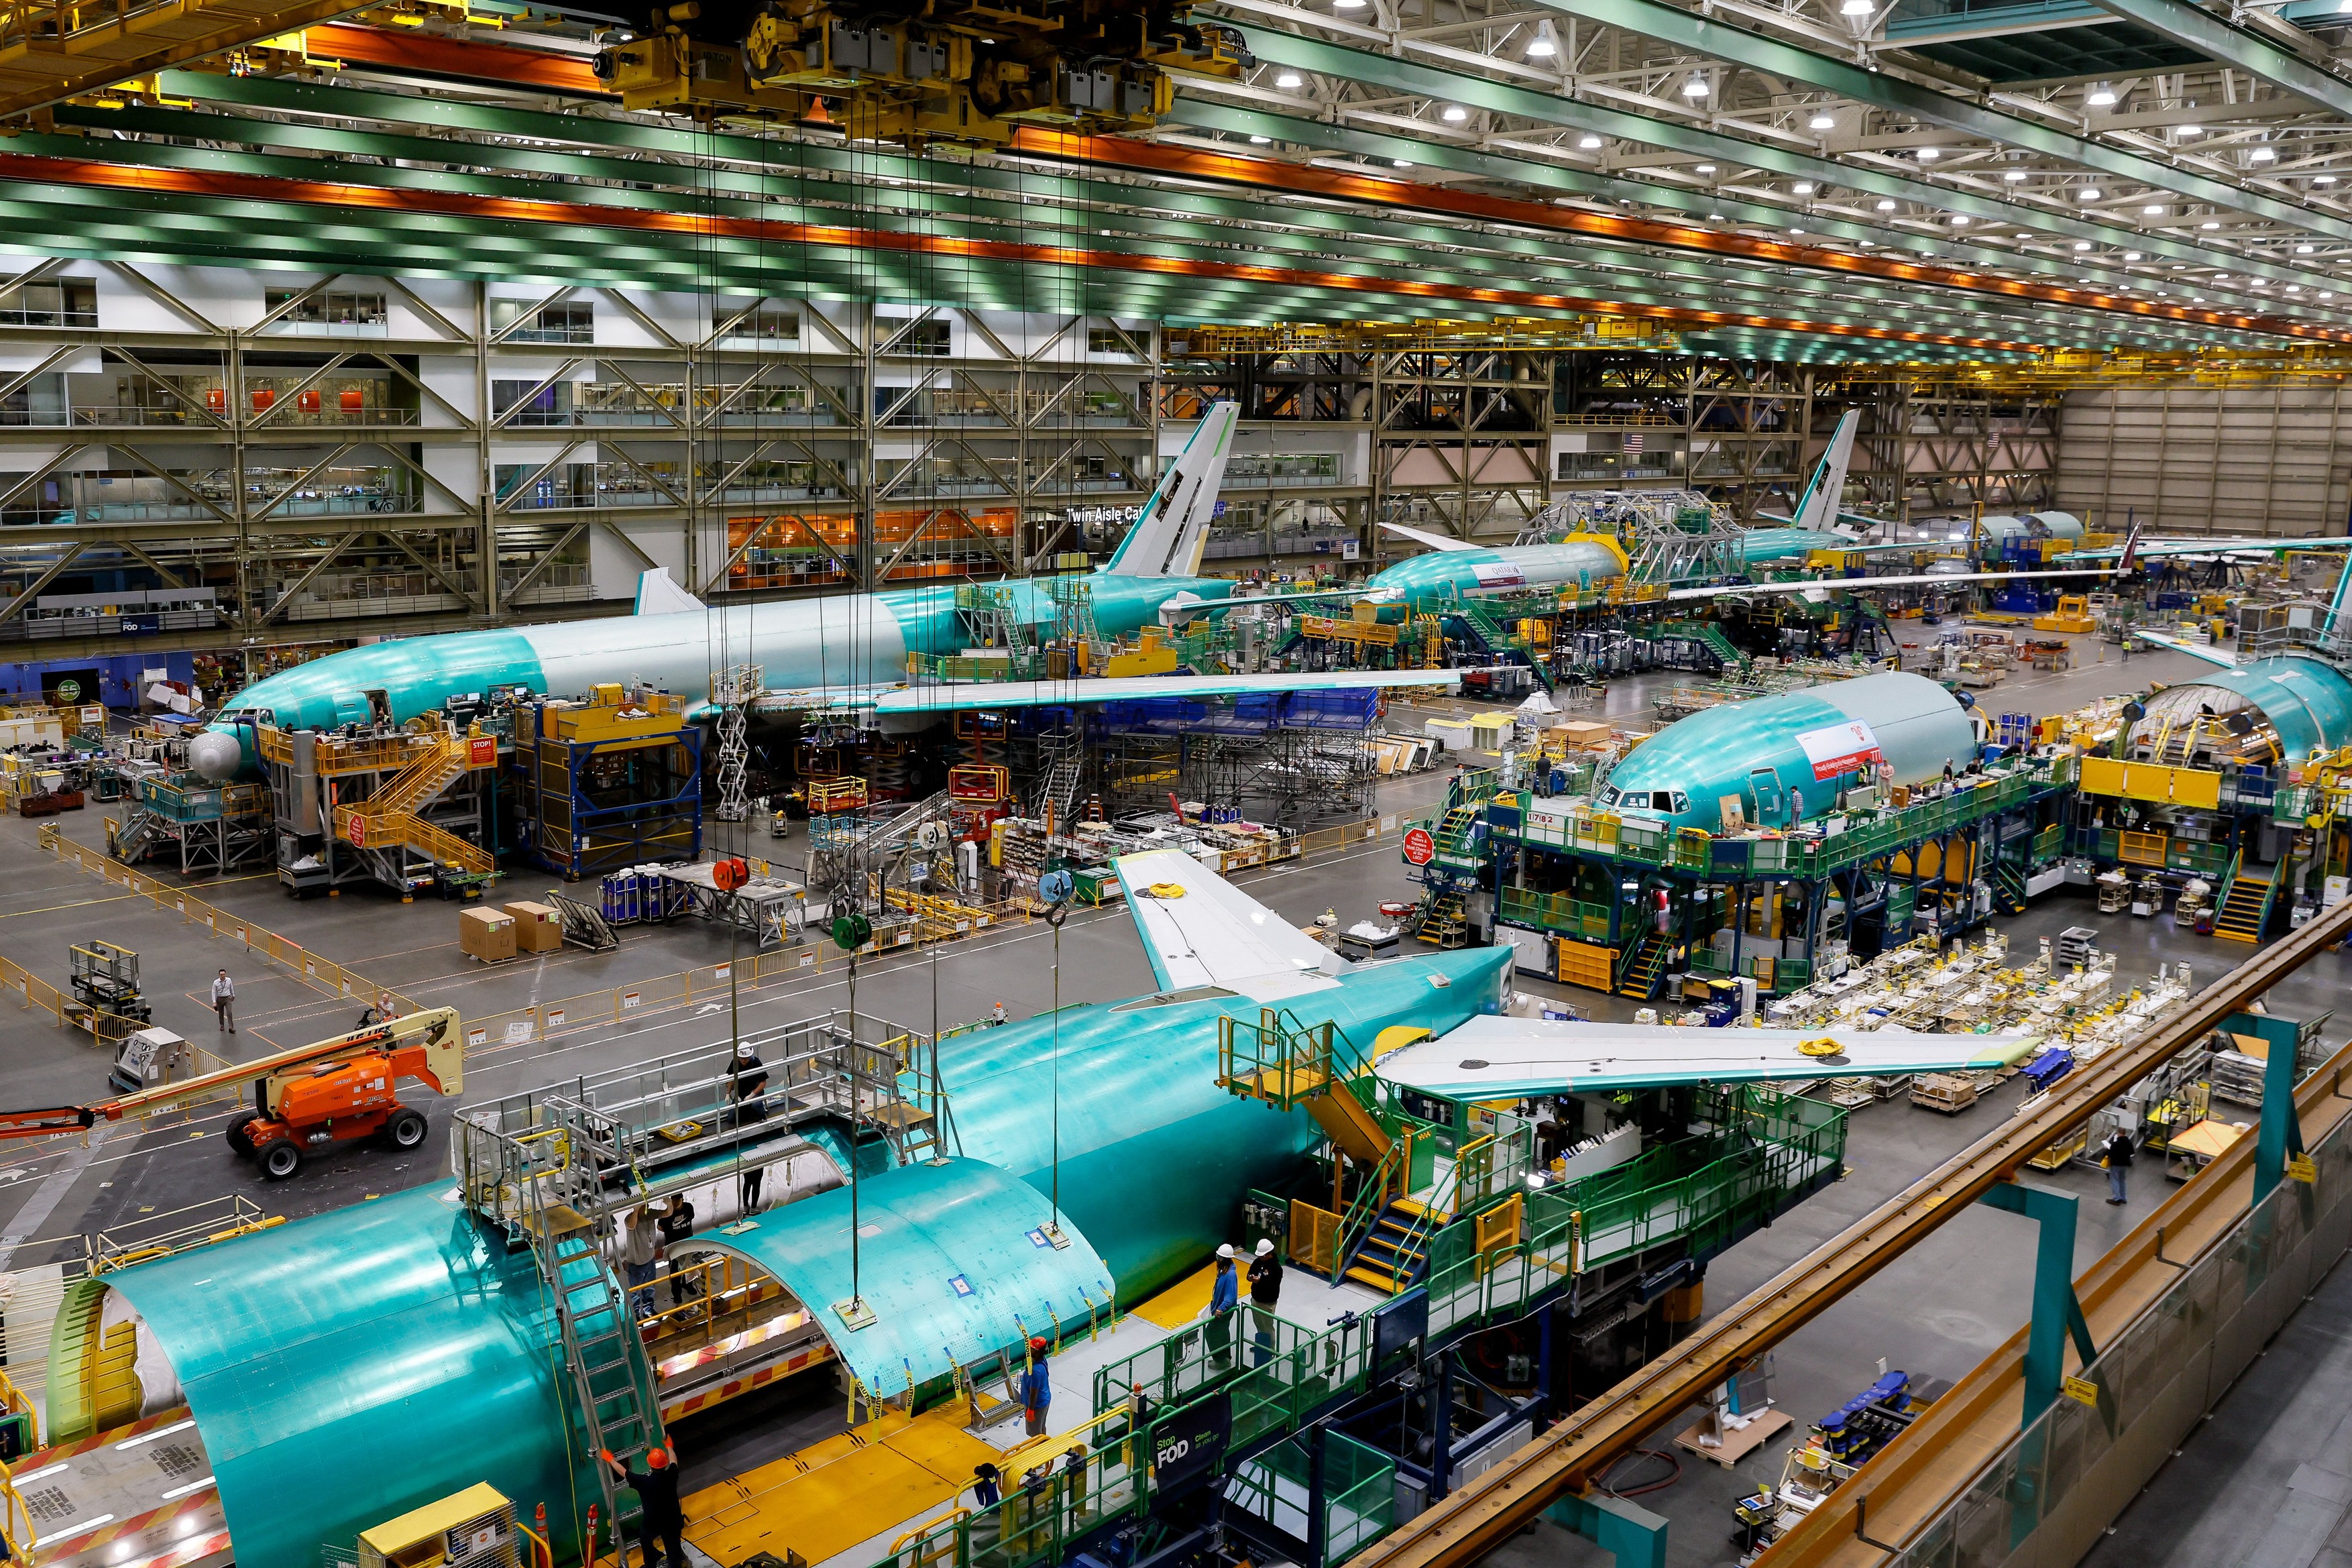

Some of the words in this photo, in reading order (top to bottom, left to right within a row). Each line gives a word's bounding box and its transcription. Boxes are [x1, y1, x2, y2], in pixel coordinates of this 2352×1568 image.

[714, 53, 732, 63] TON
[1067, 508, 1092, 522] Twin
[1095, 506, 1121, 522] Aisle
[1125, 506, 1143, 520] Caf
[1492, 566, 1513, 575] QATAR
[473, 740, 491, 748] STOP!
[1528, 814, 1553, 823] 1782
[929, 831, 935, 844] 2
[674, 1214, 685, 1222] NIKE
[1051, 1314, 1059, 1341] CAUTION
[1021, 1329, 1030, 1357] CAUTION
[950, 1361, 960, 1390] CAUTION
[857, 1381, 871, 1408] CAUTION
[2068, 1384, 2092, 1398] E-Stop
[1157, 1435, 1176, 1451] Stop
[1195, 1430, 1211, 1443] Clean
[1201, 1437, 1212, 1449] you
[1212, 1433, 1219, 1443] go
[1157, 1439, 1189, 1469] FOD
